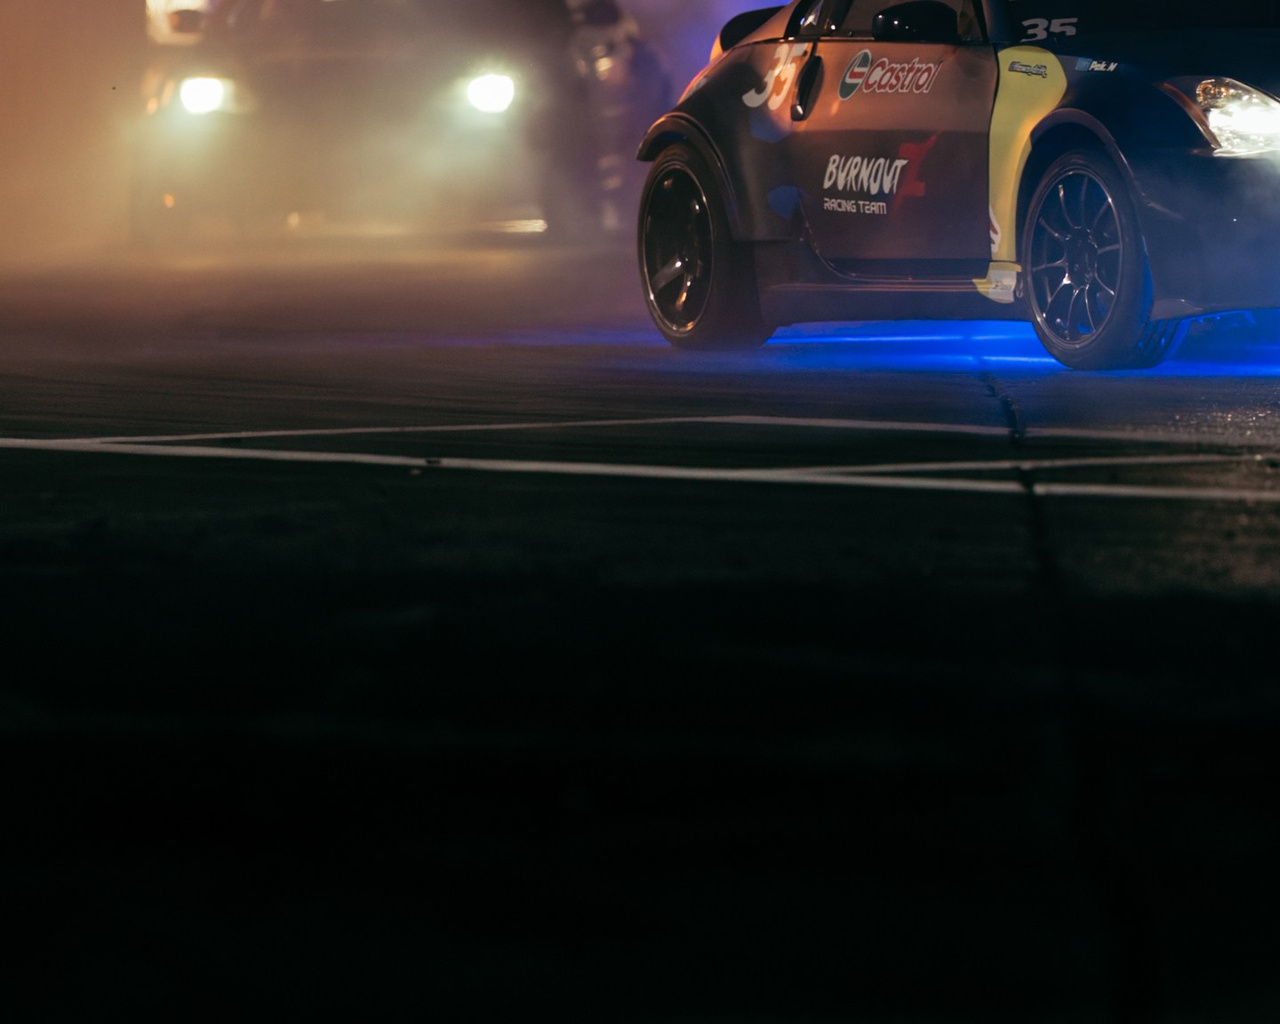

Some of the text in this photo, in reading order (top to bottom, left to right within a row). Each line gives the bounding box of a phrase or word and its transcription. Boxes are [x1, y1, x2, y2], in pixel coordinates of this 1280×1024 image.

[1020, 17, 1079, 43] 35
[742, 43, 808, 111] 35
[862, 56, 944, 94] Castrol
[823, 154, 909, 195] BURNOUT
[823, 197, 887, 215] RACING TEAM
